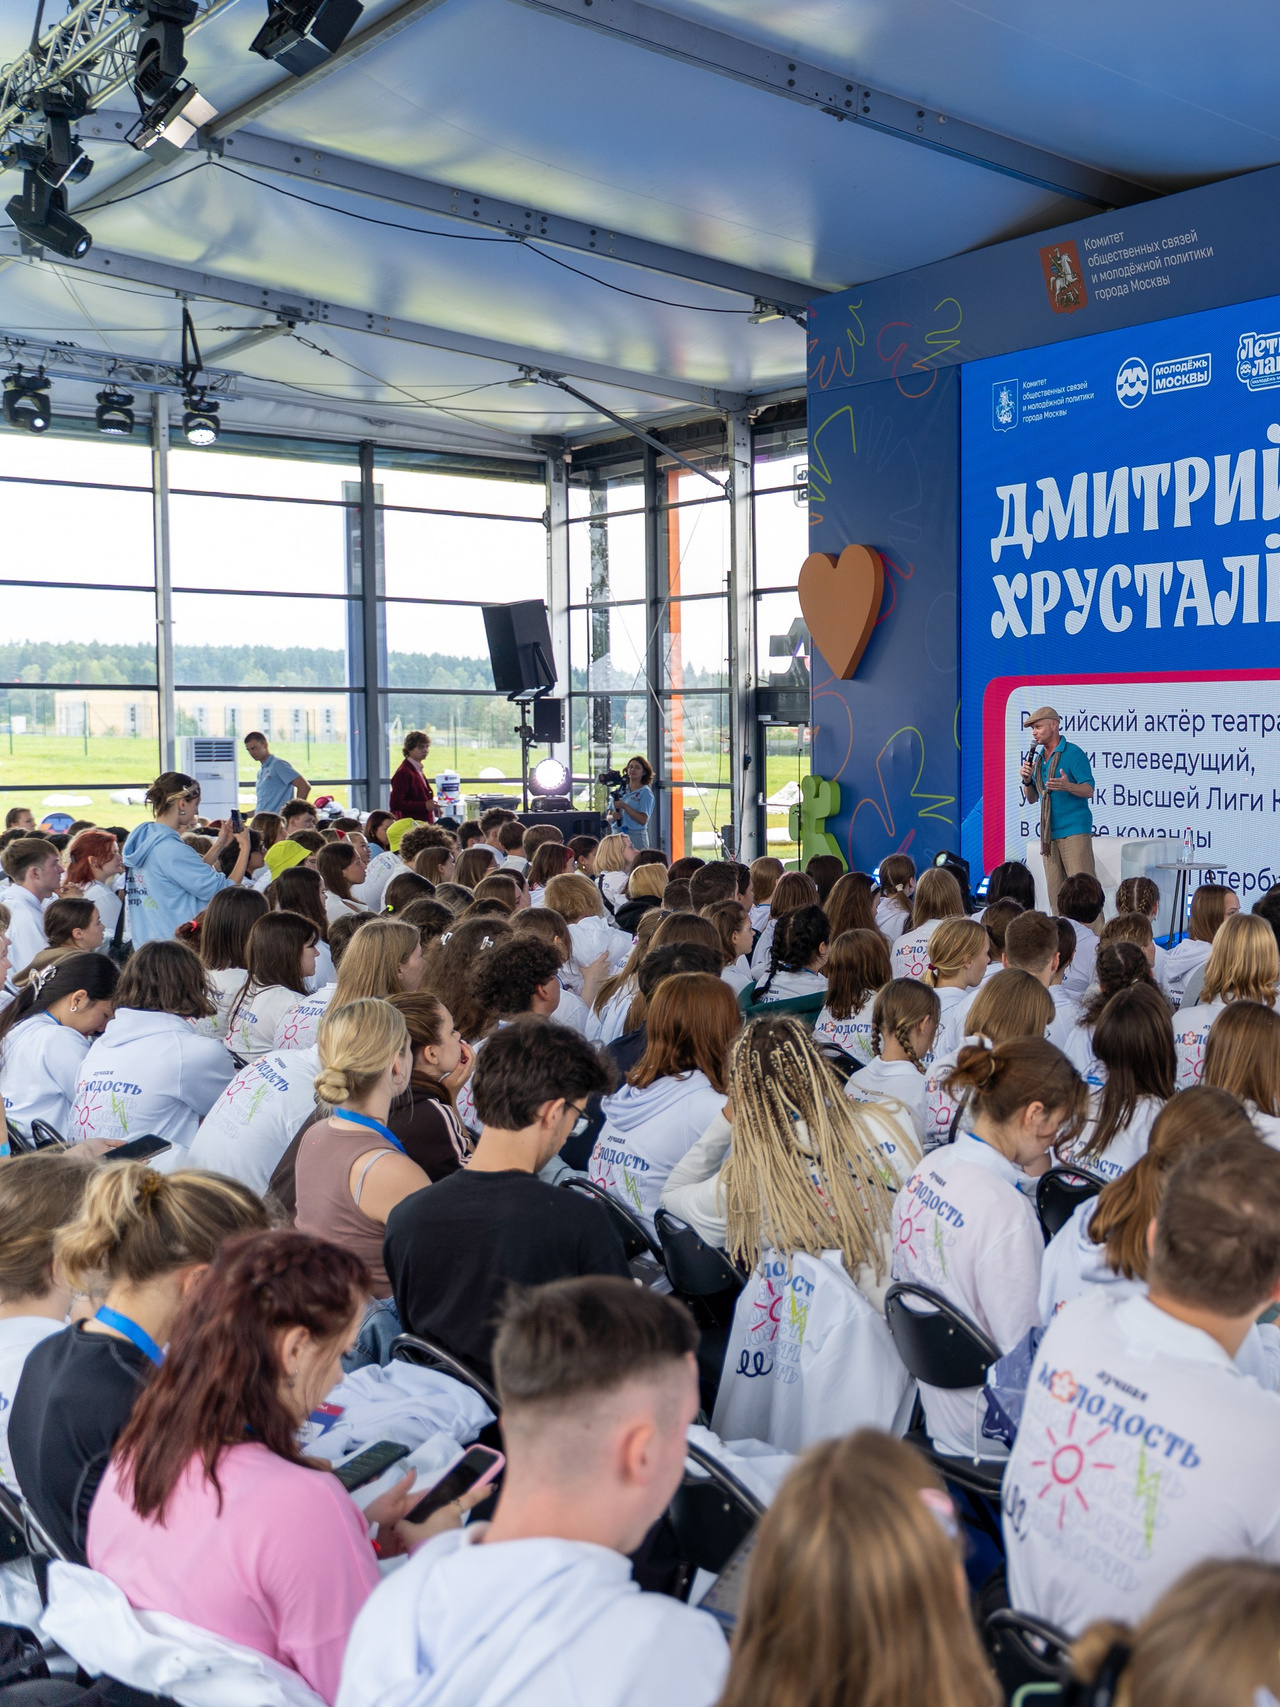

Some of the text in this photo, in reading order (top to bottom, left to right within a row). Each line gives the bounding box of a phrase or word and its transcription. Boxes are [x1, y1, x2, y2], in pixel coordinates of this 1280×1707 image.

[1084, 231, 1125, 251] Комитет
[1088, 229, 1199, 268] общественных связей
[1091, 246, 1214, 284] и молодёжной политики
[1094, 273, 1171, 301] города Москвы
[1155, 359, 1208, 376] МОЛОДЁЖЬ
[1022, 378, 1047, 389] Комитет
[1155, 370, 1208, 390] МОСКВЫ
[1022, 381, 1088, 401] общественных связей
[1022, 392, 1095, 412] и молодёжной политики
[1022, 409, 1067, 423] города Москвы
[1144, 709, 1206, 738] актёр
[1103, 747, 1256, 776] телеведущий,
[1113, 784, 1199, 810] Высшей
[1206, 787, 1264, 812] Лиги
